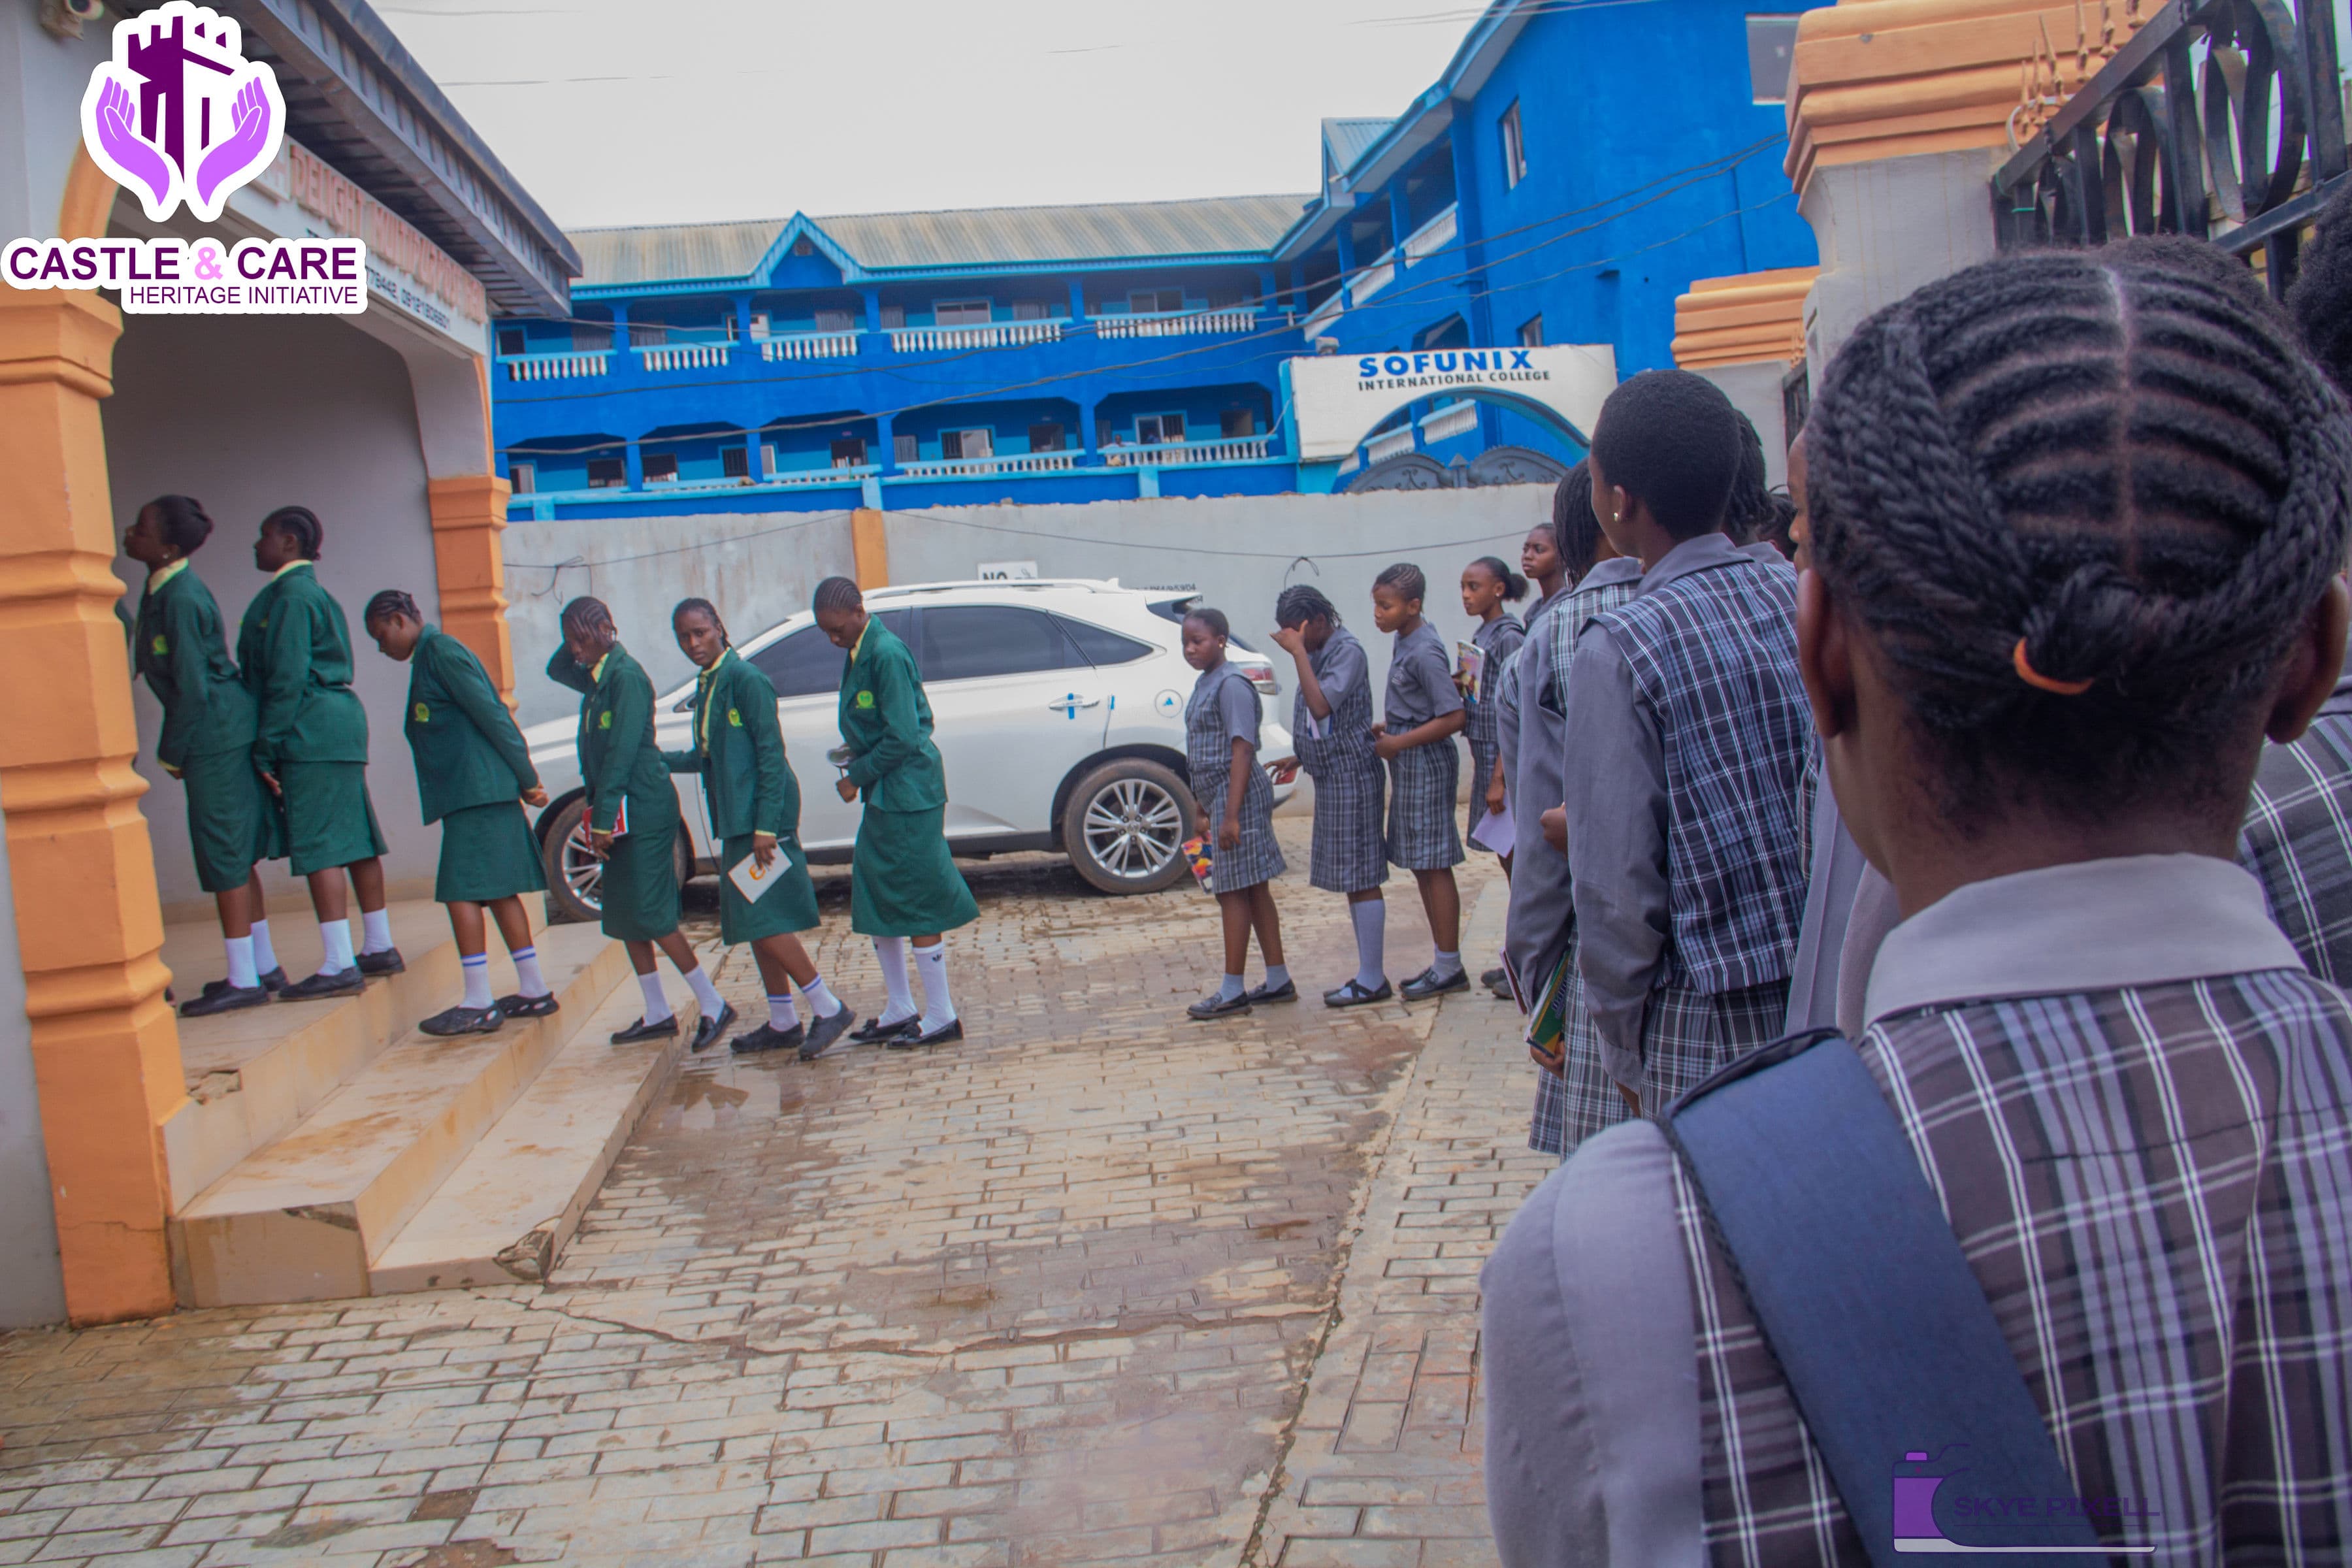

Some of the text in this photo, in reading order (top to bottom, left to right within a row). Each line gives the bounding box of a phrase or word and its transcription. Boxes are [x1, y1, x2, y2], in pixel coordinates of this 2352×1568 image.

[1359, 350, 1533, 378] SOFUNIX
[1358, 370, 1551, 391] INTERNATIONAL COLLEGE
